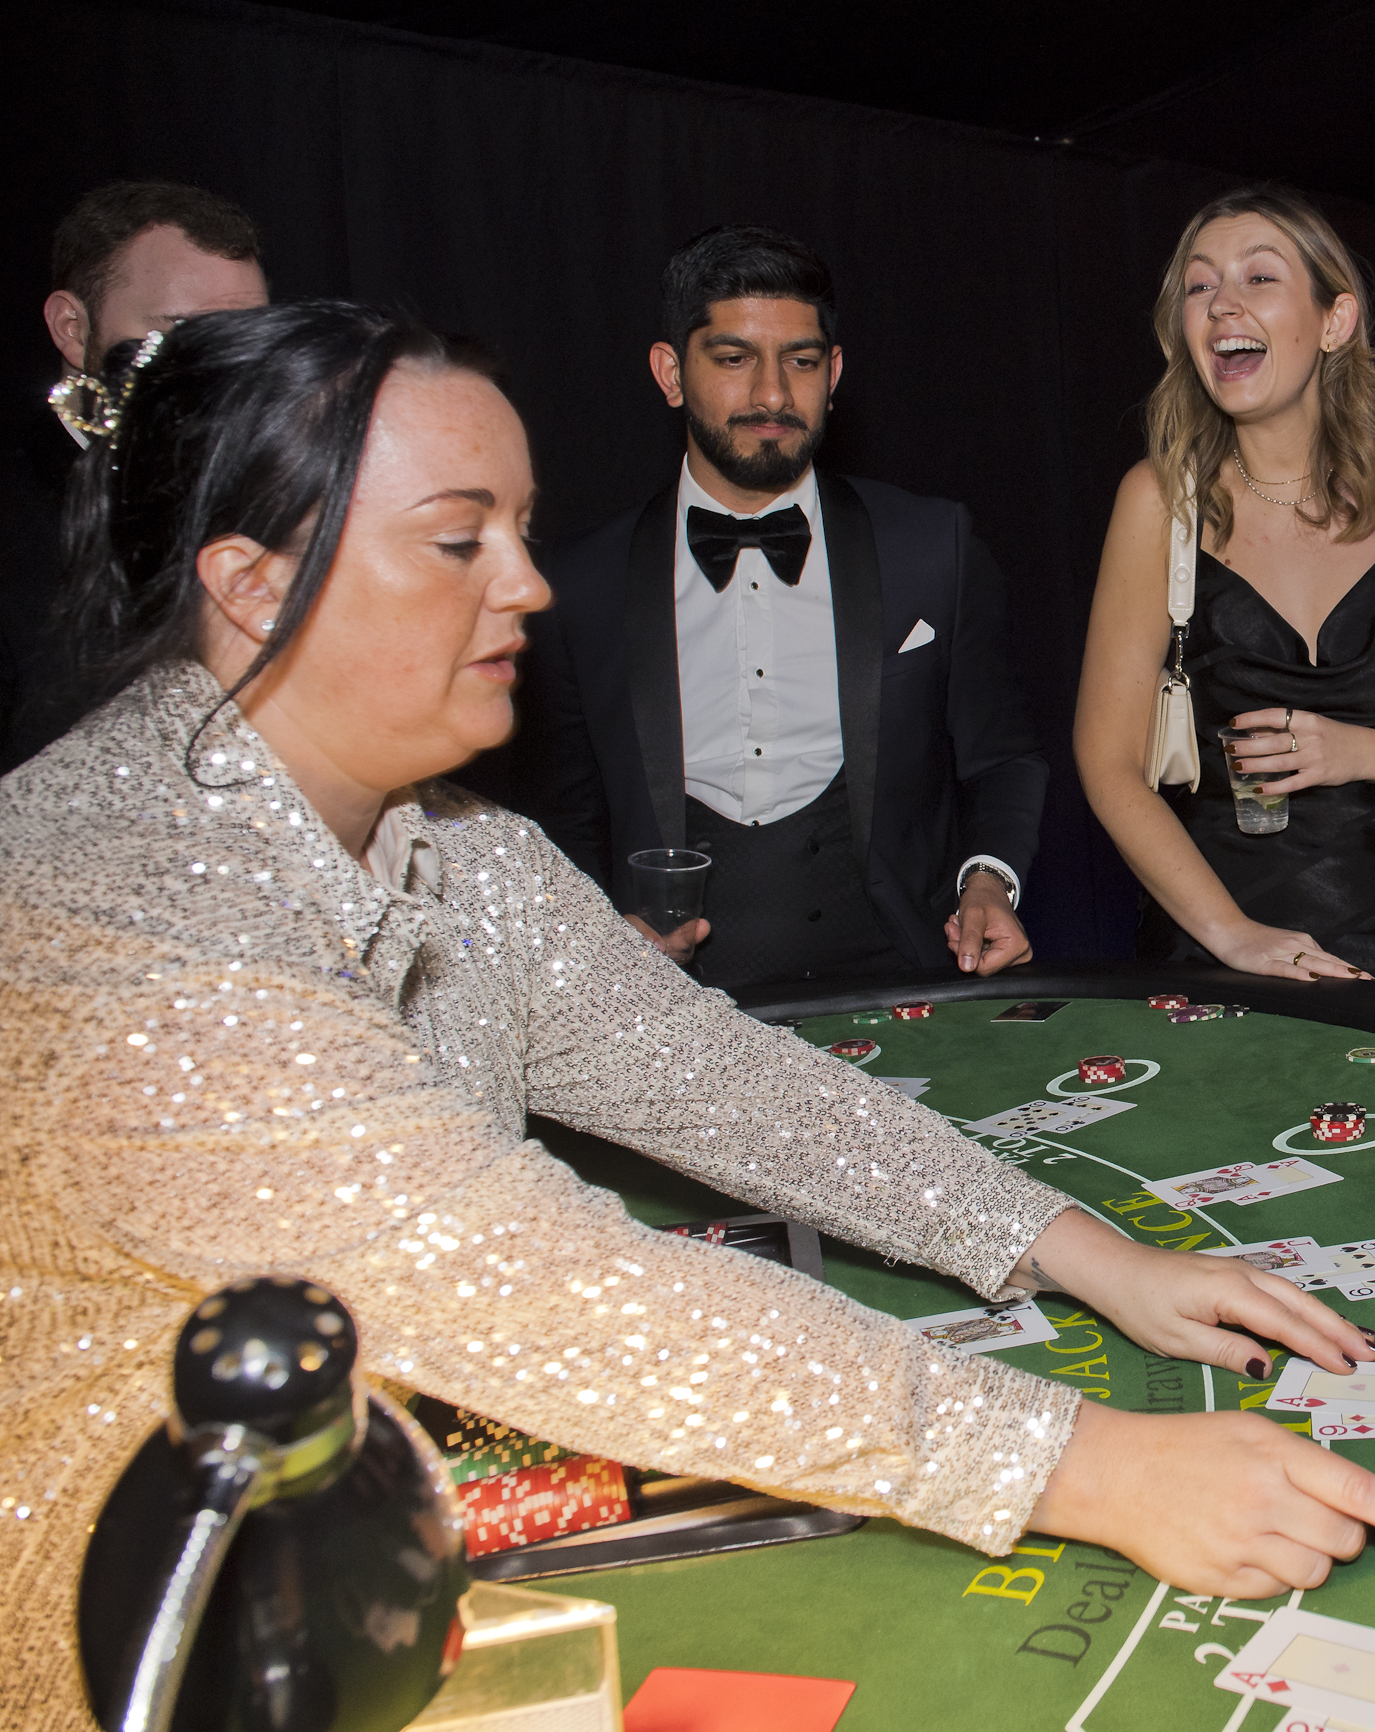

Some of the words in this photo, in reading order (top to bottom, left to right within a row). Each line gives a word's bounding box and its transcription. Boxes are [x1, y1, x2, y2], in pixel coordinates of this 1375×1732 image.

[1233, 1163, 1255, 1173] Q
[1280, 1159, 1301, 1168] A
[1174, 1199, 1196, 1208] Q
[1287, 1239, 1312, 1247] J
[1348, 1286, 1374, 1297] 6
[1275, 1396, 1304, 1407] A
[1318, 1425, 1348, 1436] 9
[1015, 1549, 1139, 1669] Deal
[1158, 1594, 1214, 1634] PA
[1230, 1671, 1267, 1689] A
